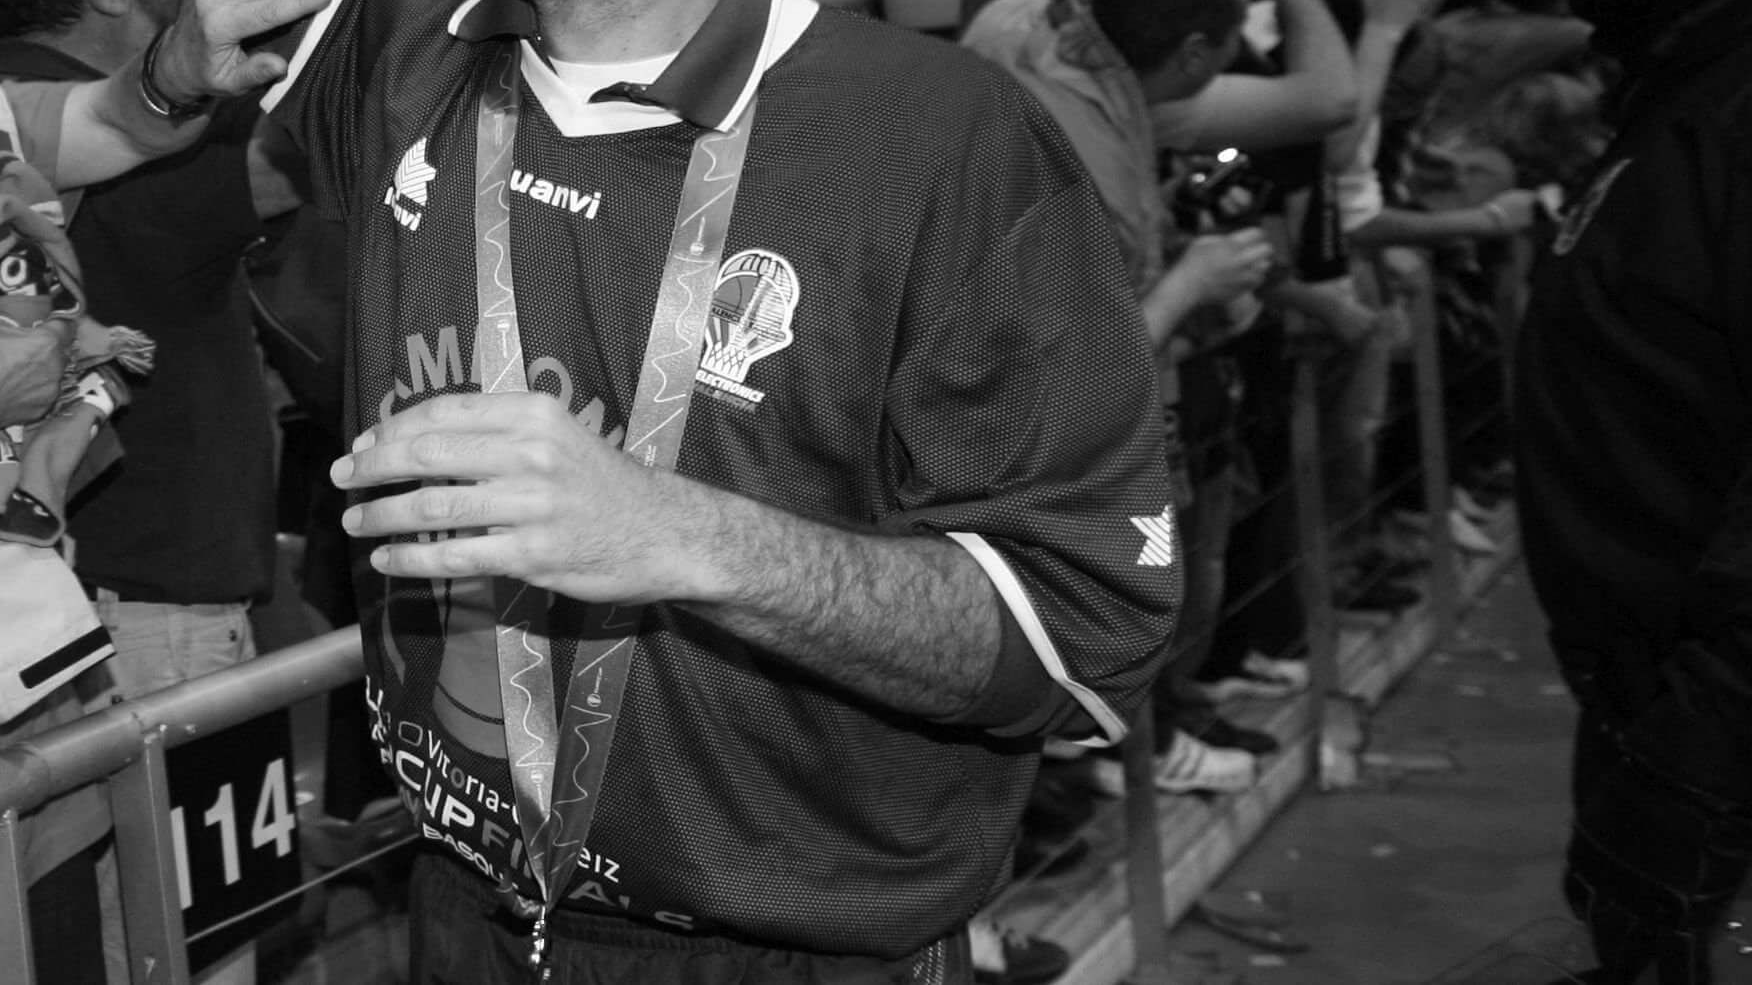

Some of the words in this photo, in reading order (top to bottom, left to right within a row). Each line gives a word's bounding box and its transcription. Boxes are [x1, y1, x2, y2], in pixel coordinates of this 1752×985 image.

[510, 168, 602, 219] uanvi
[395, 749, 476, 828] CUP
[426, 728, 520, 825] Vitoria-
[576, 846, 621, 884] eiz
